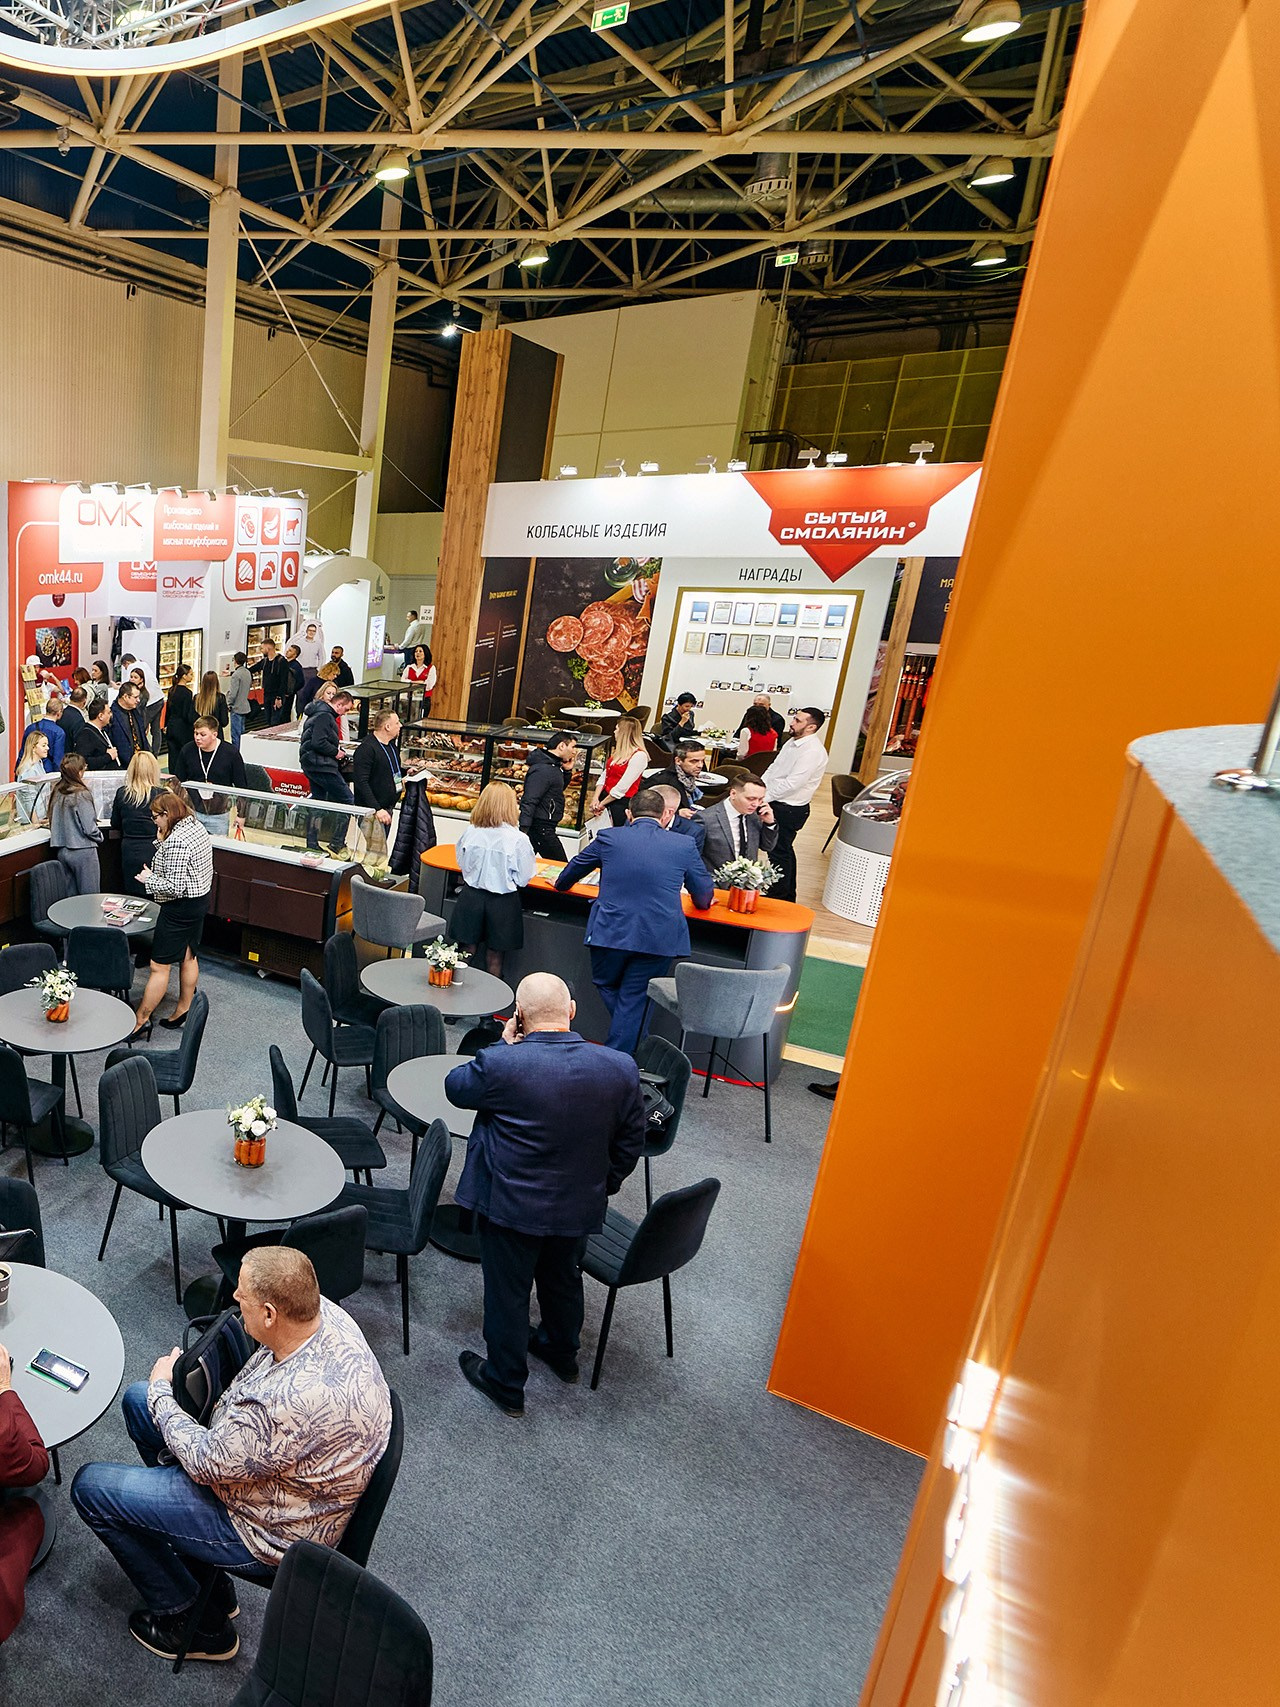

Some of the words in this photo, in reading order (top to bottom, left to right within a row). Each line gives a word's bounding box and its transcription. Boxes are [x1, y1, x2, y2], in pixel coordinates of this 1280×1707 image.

[804, 509, 888, 525] СЫТЫЙ
[526, 524, 600, 539] КОЛБАСНЫЕ
[604, 522, 667, 539] ИЗДЕЛИЯ
[780, 526, 906, 540] СМОЛЯНИН
[38, 569, 83, 585] omk44.ru
[738, 568, 803, 583] НАГРАДЫ
